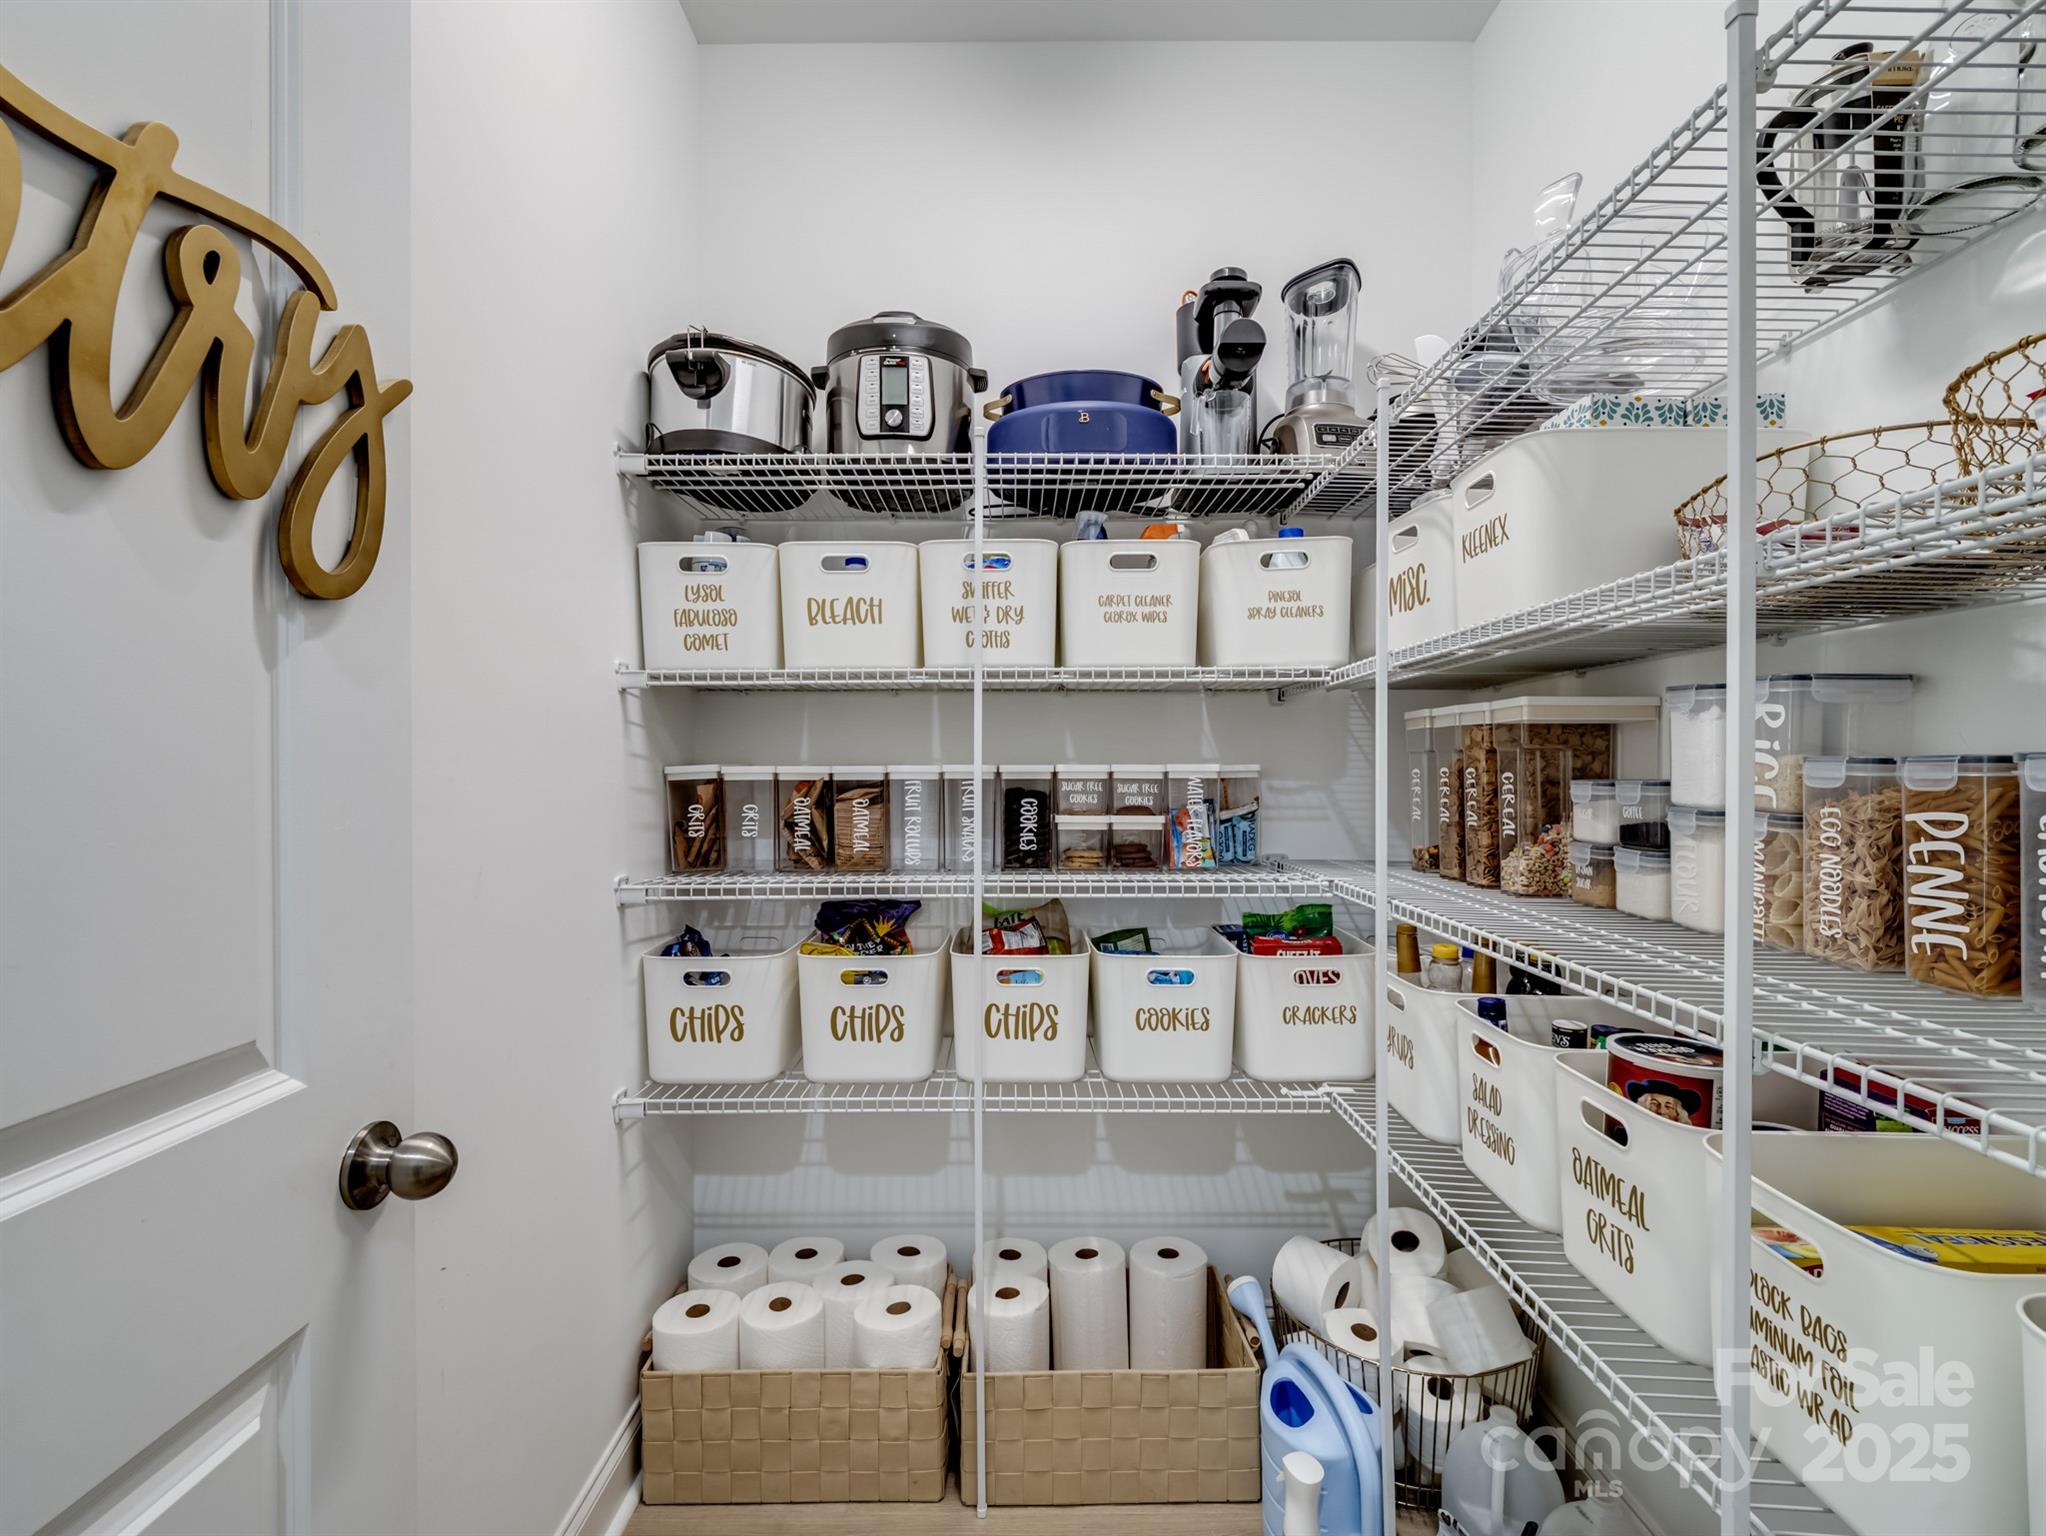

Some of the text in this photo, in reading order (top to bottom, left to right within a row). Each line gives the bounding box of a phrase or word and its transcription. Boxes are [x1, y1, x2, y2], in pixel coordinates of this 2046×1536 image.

[0, 60, 413, 600] try
[1461, 512, 1511, 563] KLEENEX
[684, 583, 725, 603] LYSOL
[806, 597, 883, 627] BLEACH
[1098, 594, 1173, 607] CARPET CLEANER
[1247, 604, 1324, 620] SPRAY CLEANERS
[1268, 590, 1302, 603] PINESOL
[673, 607, 738, 628] FABULOSO
[996, 605, 1024, 625] DRY
[1103, 610, 1168, 624] CLOROX WIPES
[683, 632, 729, 652] COMET
[965, 629, 1010, 648] COTHS
[904, 781, 921, 811] FRUIT
[1411, 768, 1421, 822] CEREAL
[1439, 767, 1450, 823] CEREAL
[1465, 767, 1478, 828] CEREAL
[1501, 771, 1516, 838] CEREAL
[687, 804, 705, 838] GRITS
[741, 804, 759, 838] GRITS
[793, 797, 811, 852] OATMEAL
[852, 798, 870, 854] OATMEAL
[1020, 798, 1038, 851] COOKIES
[1819, 806, 1843, 939] EGG NOODLES
[1904, 811, 1970, 961] PENNE
[669, 1004, 745, 1043] CHIPS
[830, 1003, 905, 1043] CHIPS
[984, 1002, 1059, 1041] CHIPS
[1135, 1006, 1210, 1032] COOKIES
[1282, 1004, 1357, 1026] CRACKERS
[1472, 1072, 1503, 1117] SALAD
[1467, 1107, 1515, 1166] DRESSING
[1572, 1147, 1651, 1232] OATMEAL
[1587, 1208, 1635, 1275] GRITS
[1750, 1268, 1848, 1363] LOCK BAGS
[1751, 1344, 1853, 1447] ASTIC WRAP
[1822, 1360, 1860, 1413] FOIL
